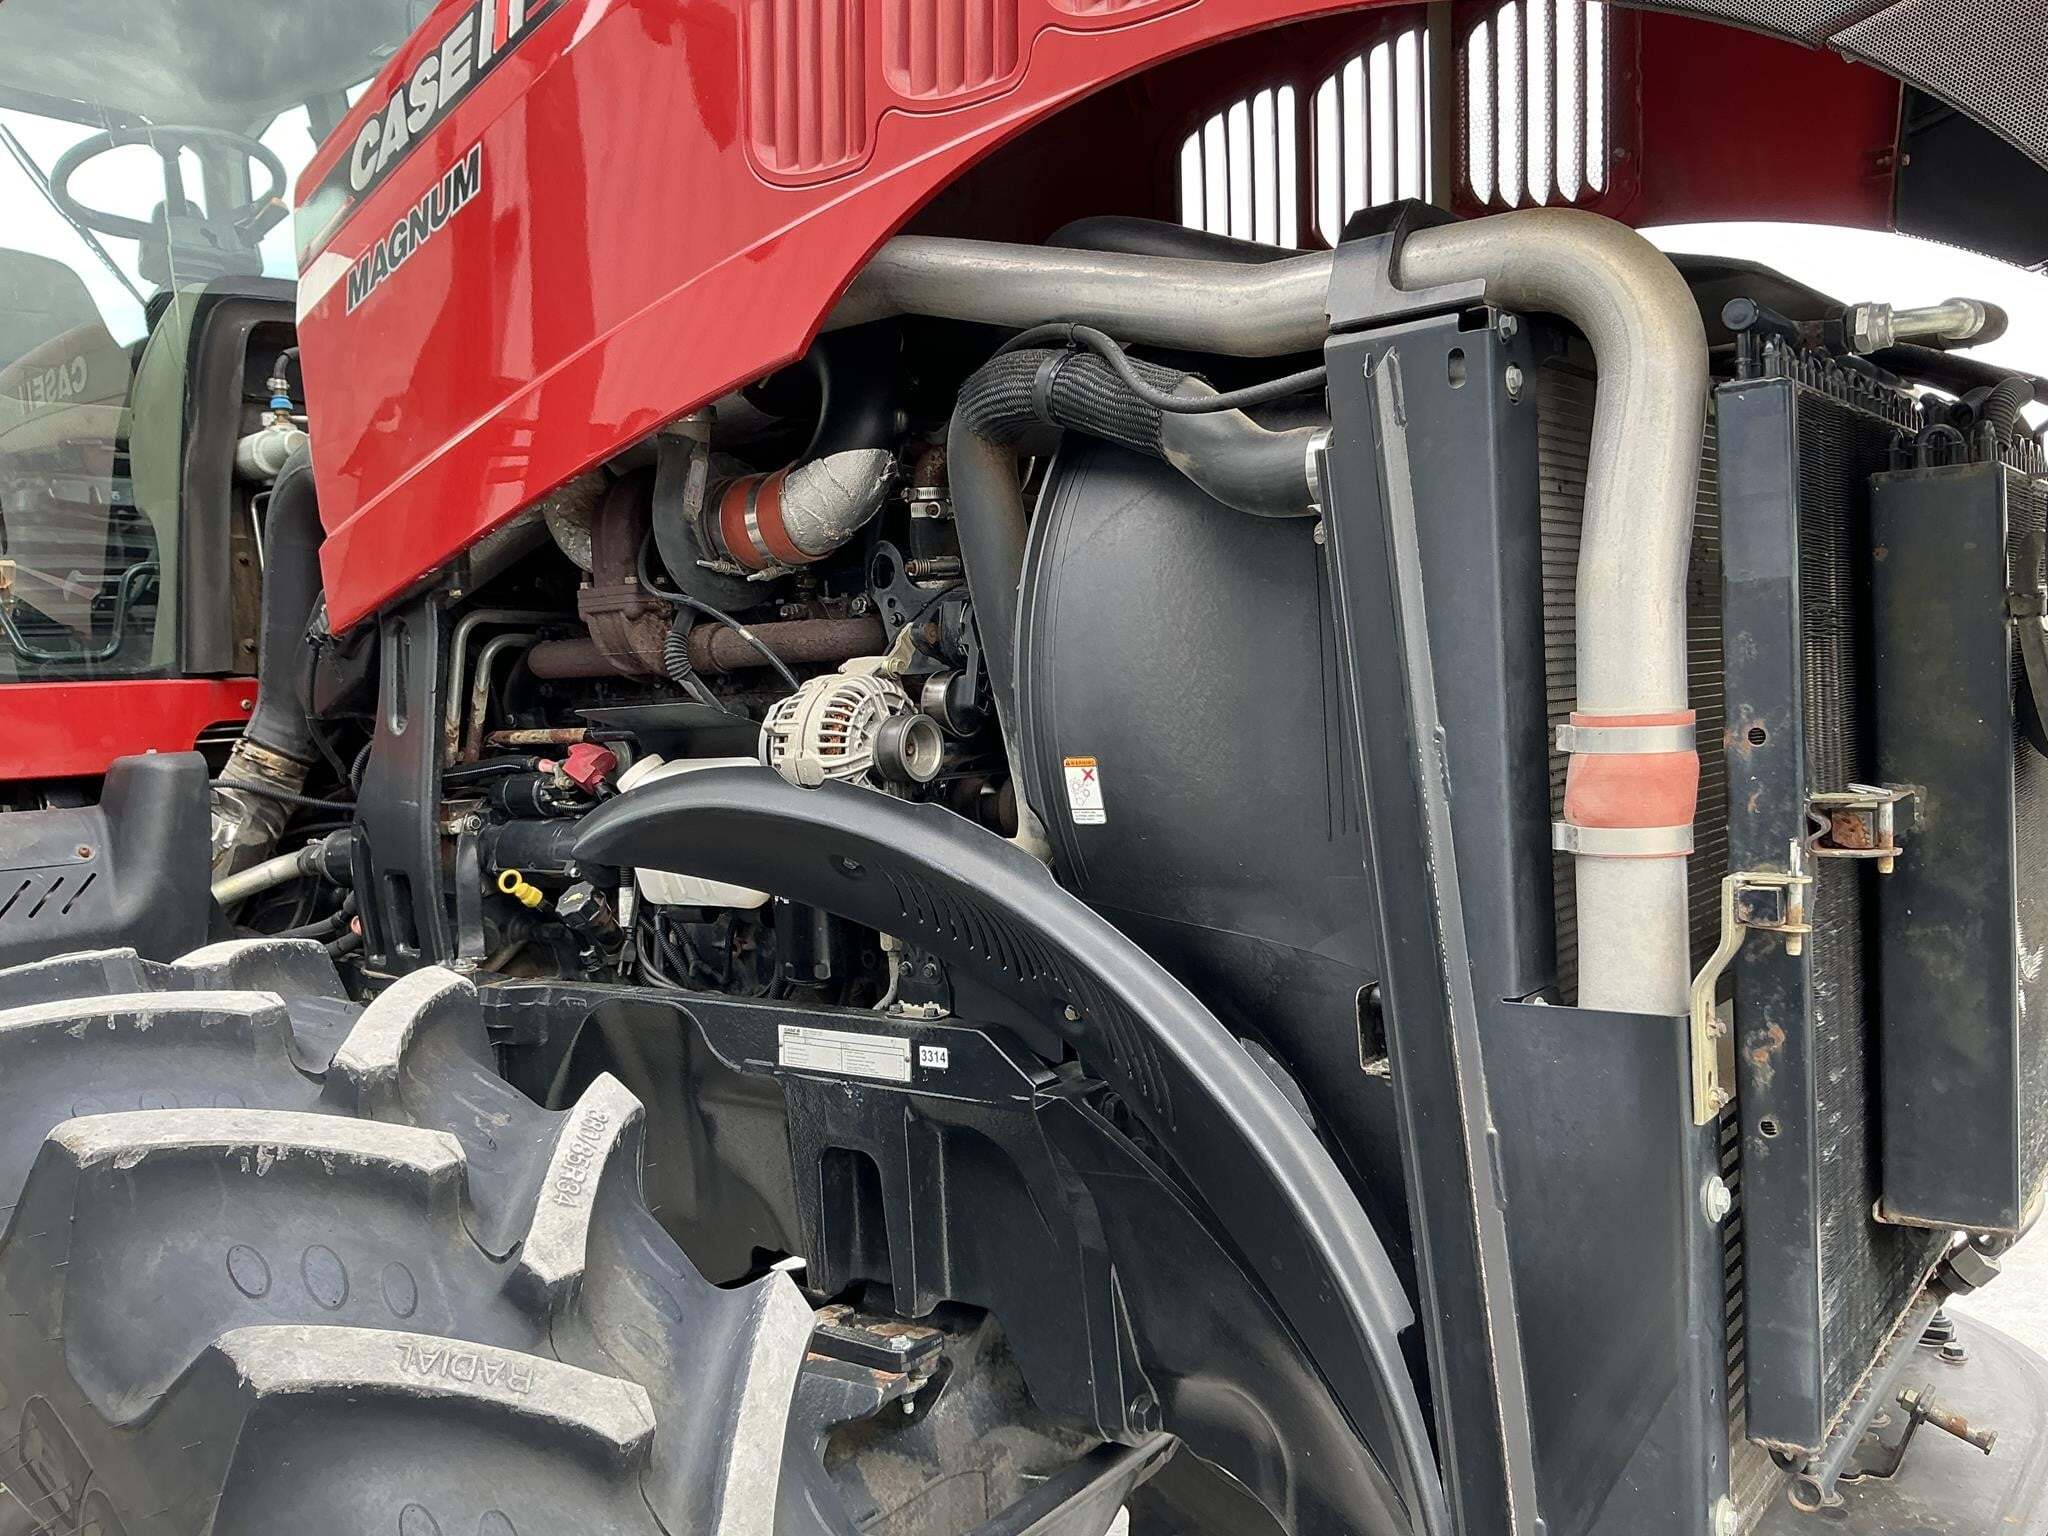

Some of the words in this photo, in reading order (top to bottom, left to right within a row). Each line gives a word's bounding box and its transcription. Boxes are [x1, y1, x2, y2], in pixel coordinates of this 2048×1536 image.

[346, 141, 482, 317] MAGNUM
[921, 1050, 947, 1064] 3314
[396, 1344, 535, 1395] RADIAL
